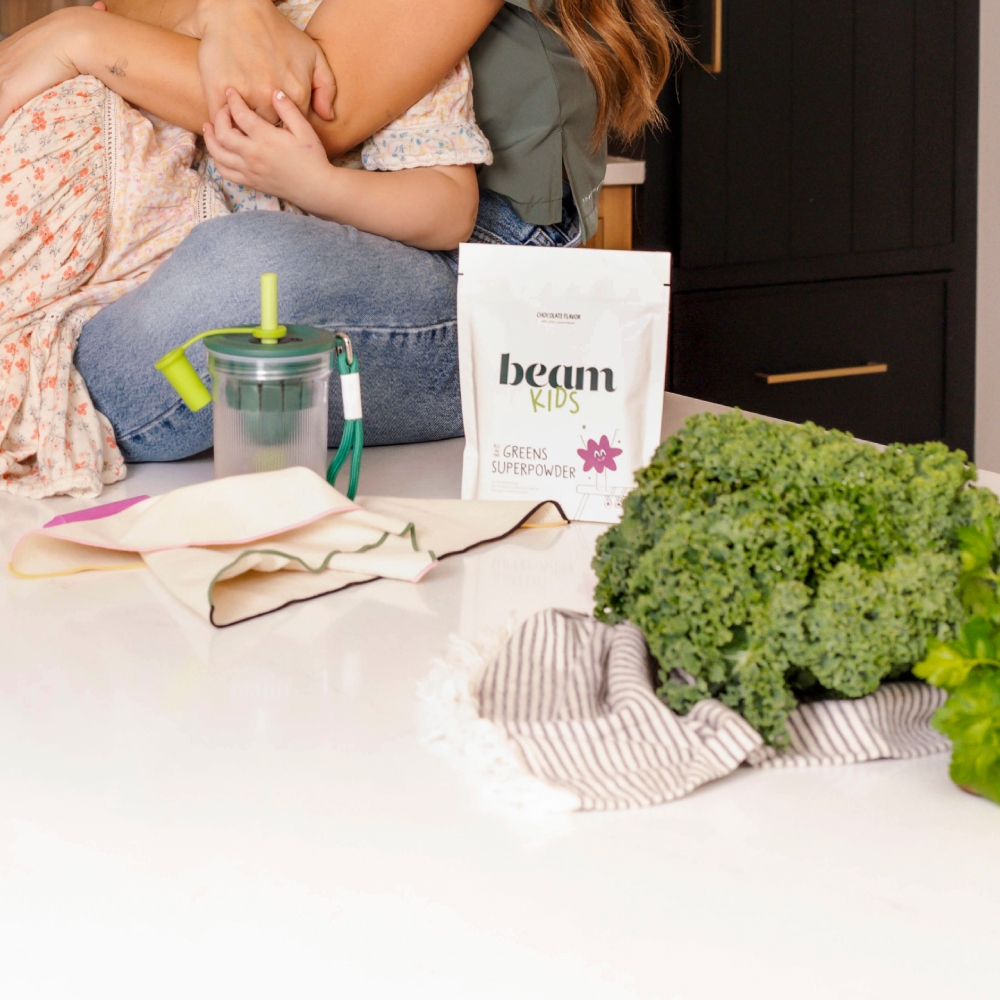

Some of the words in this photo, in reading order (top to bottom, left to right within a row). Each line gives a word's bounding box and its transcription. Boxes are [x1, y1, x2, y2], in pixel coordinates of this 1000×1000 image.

[536, 312, 563, 320] CHOCOLATE
[499, 353, 618, 393] beam
[530, 386, 580, 414] KIDS
[503, 444, 548, 461] GREENS
[491, 460, 577, 479] SUPERPOWDER
